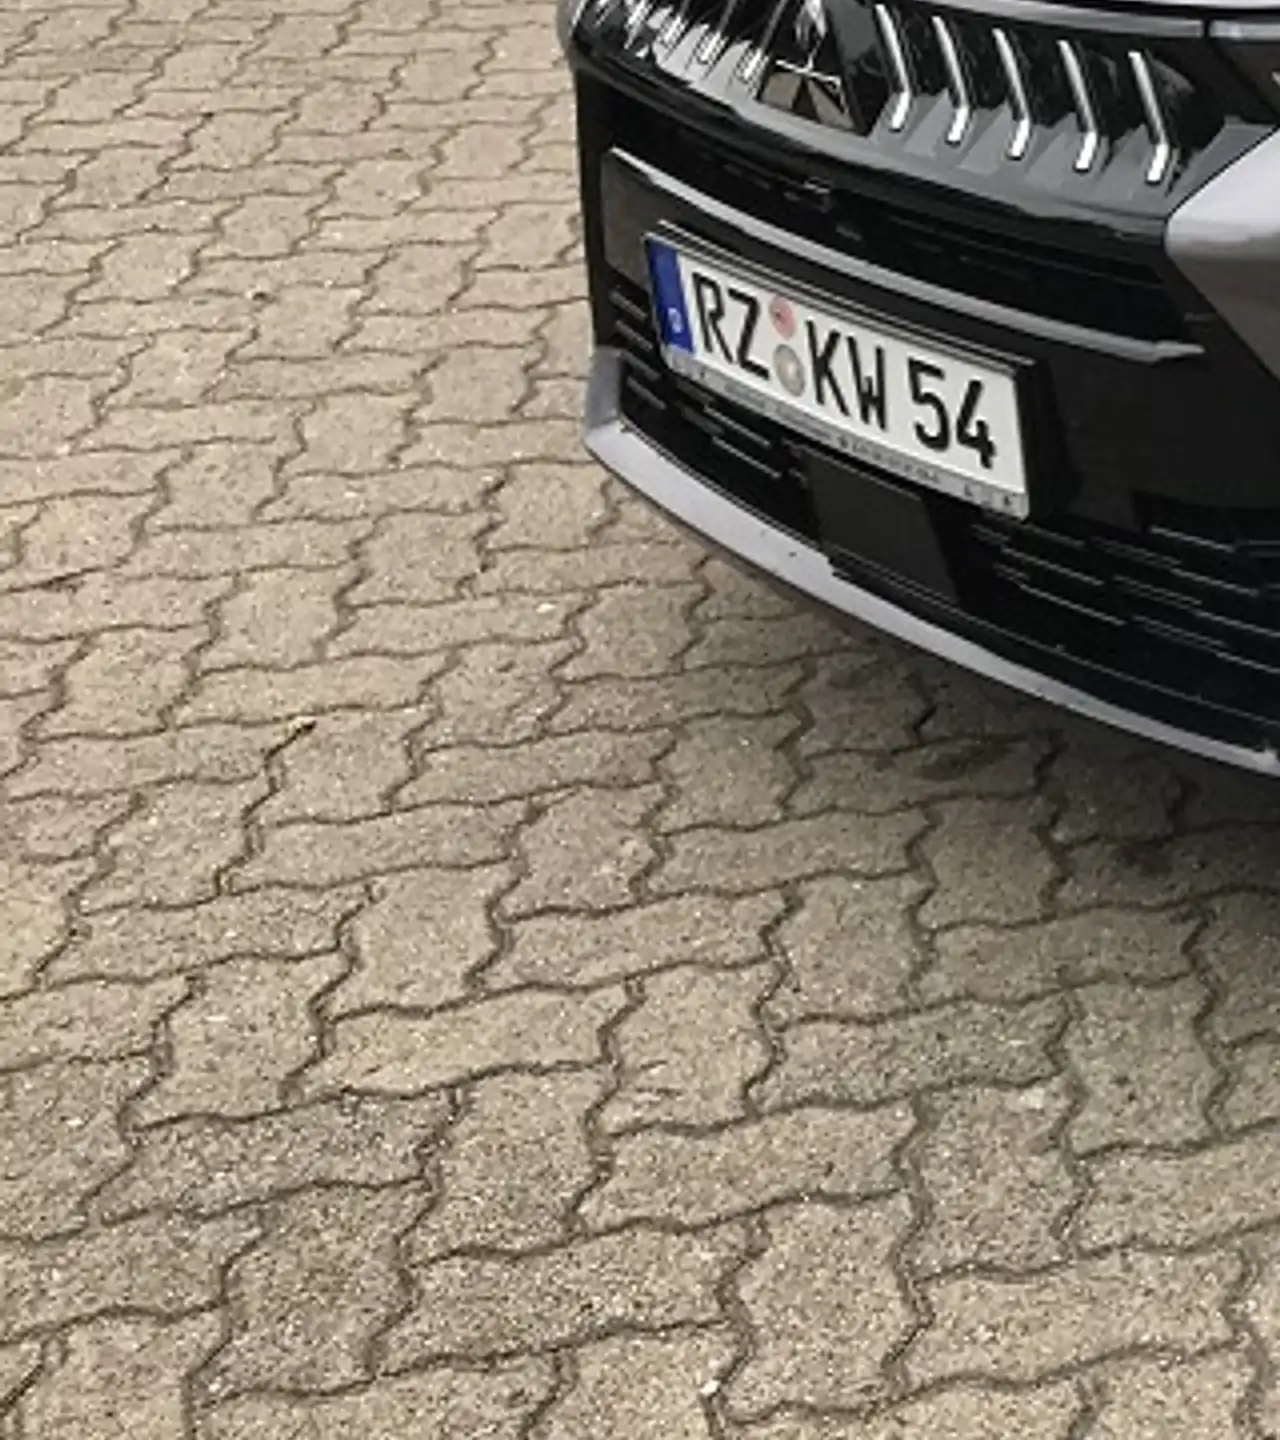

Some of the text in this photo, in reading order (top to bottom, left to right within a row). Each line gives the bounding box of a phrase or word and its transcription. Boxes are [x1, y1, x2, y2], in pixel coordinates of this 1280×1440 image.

[692, 273, 770, 380] RZ
[804, 320, 888, 430] KW
[907, 358, 996, 468] 54
